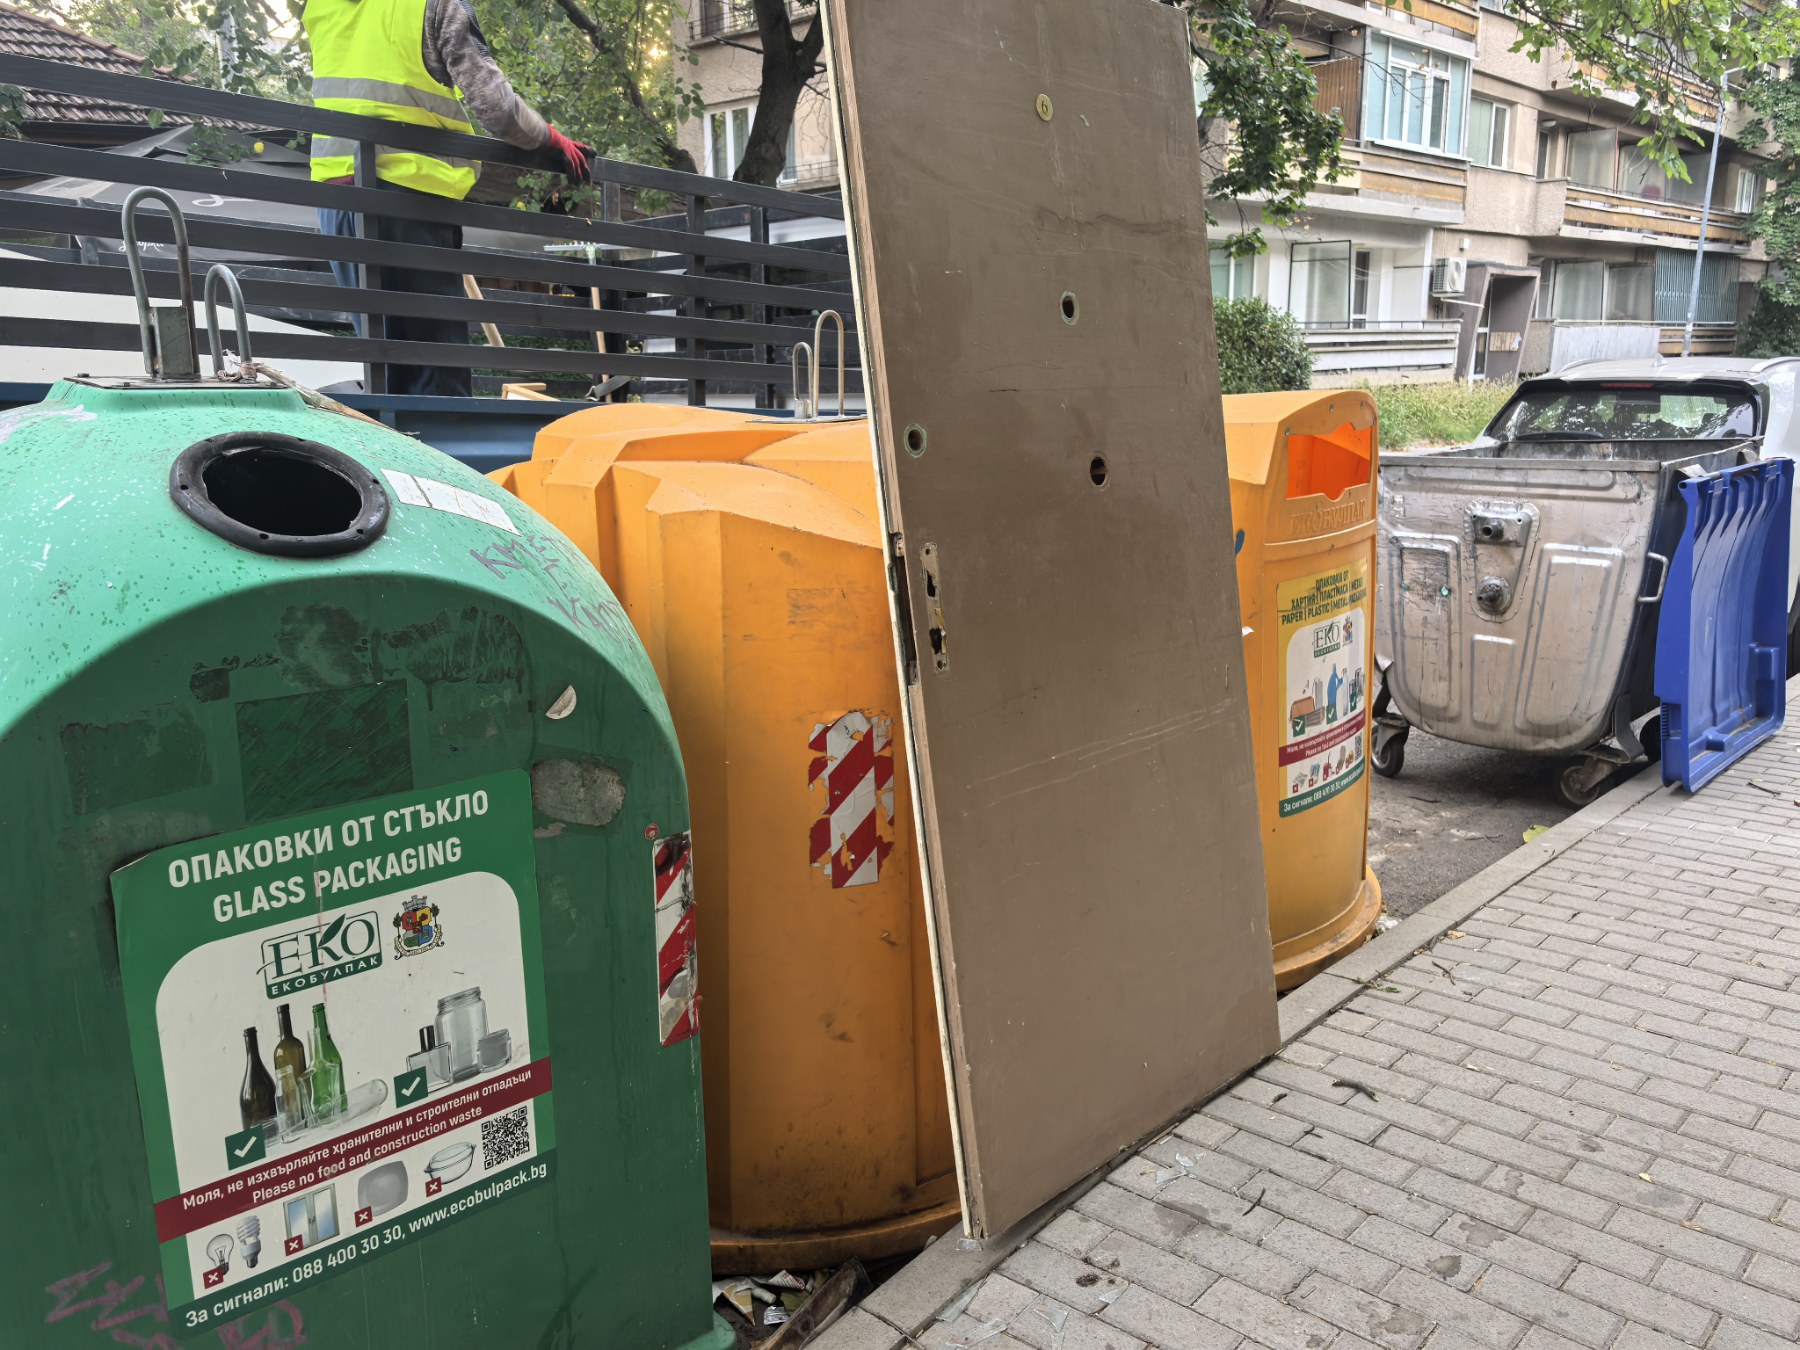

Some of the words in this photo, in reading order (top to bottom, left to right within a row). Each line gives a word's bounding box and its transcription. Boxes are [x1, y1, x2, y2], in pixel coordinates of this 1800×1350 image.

[1281, 610, 1303, 625] PAPER
[1308, 602, 1329, 618] PLASTIC
[168, 825, 334, 888] ОПАКОВКИ
[341, 815, 376, 847] ОТ
[383, 790, 489, 837] СТЪКЛО
[213, 876, 306, 923] GLASS
[313, 837, 462, 898] PACKAGING
[271, 956, 378, 995] ЕКОБУЛПАК
[183, 1189, 224, 1210] Моля,
[227, 1180, 244, 1194] не
[247, 1147, 330, 1187] изхвърляйте
[332, 1119, 403, 1155] хранителни
[405, 1117, 413, 1127] и
[416, 1089, 480, 1121] строителни
[482, 1070, 532, 1097] отпадъци
[252, 1178, 296, 1203] Please
[299, 1172, 314, 1186] no
[317, 1157, 346, 1179] food
[349, 1149, 371, 1166] and
[374, 1120, 447, 1157] construction
[449, 1106, 482, 1126] waste
[186, 1309, 209, 1328] За
[213, 1276, 289, 1316] сигнали:
[293, 1258, 323, 1283] 088
[327, 1245, 357, 1268] 400
[360, 1234, 380, 1255] 30
[383, 1225, 406, 1245] 30,
[409, 1163, 547, 1233] www.ecobulpack.bg
